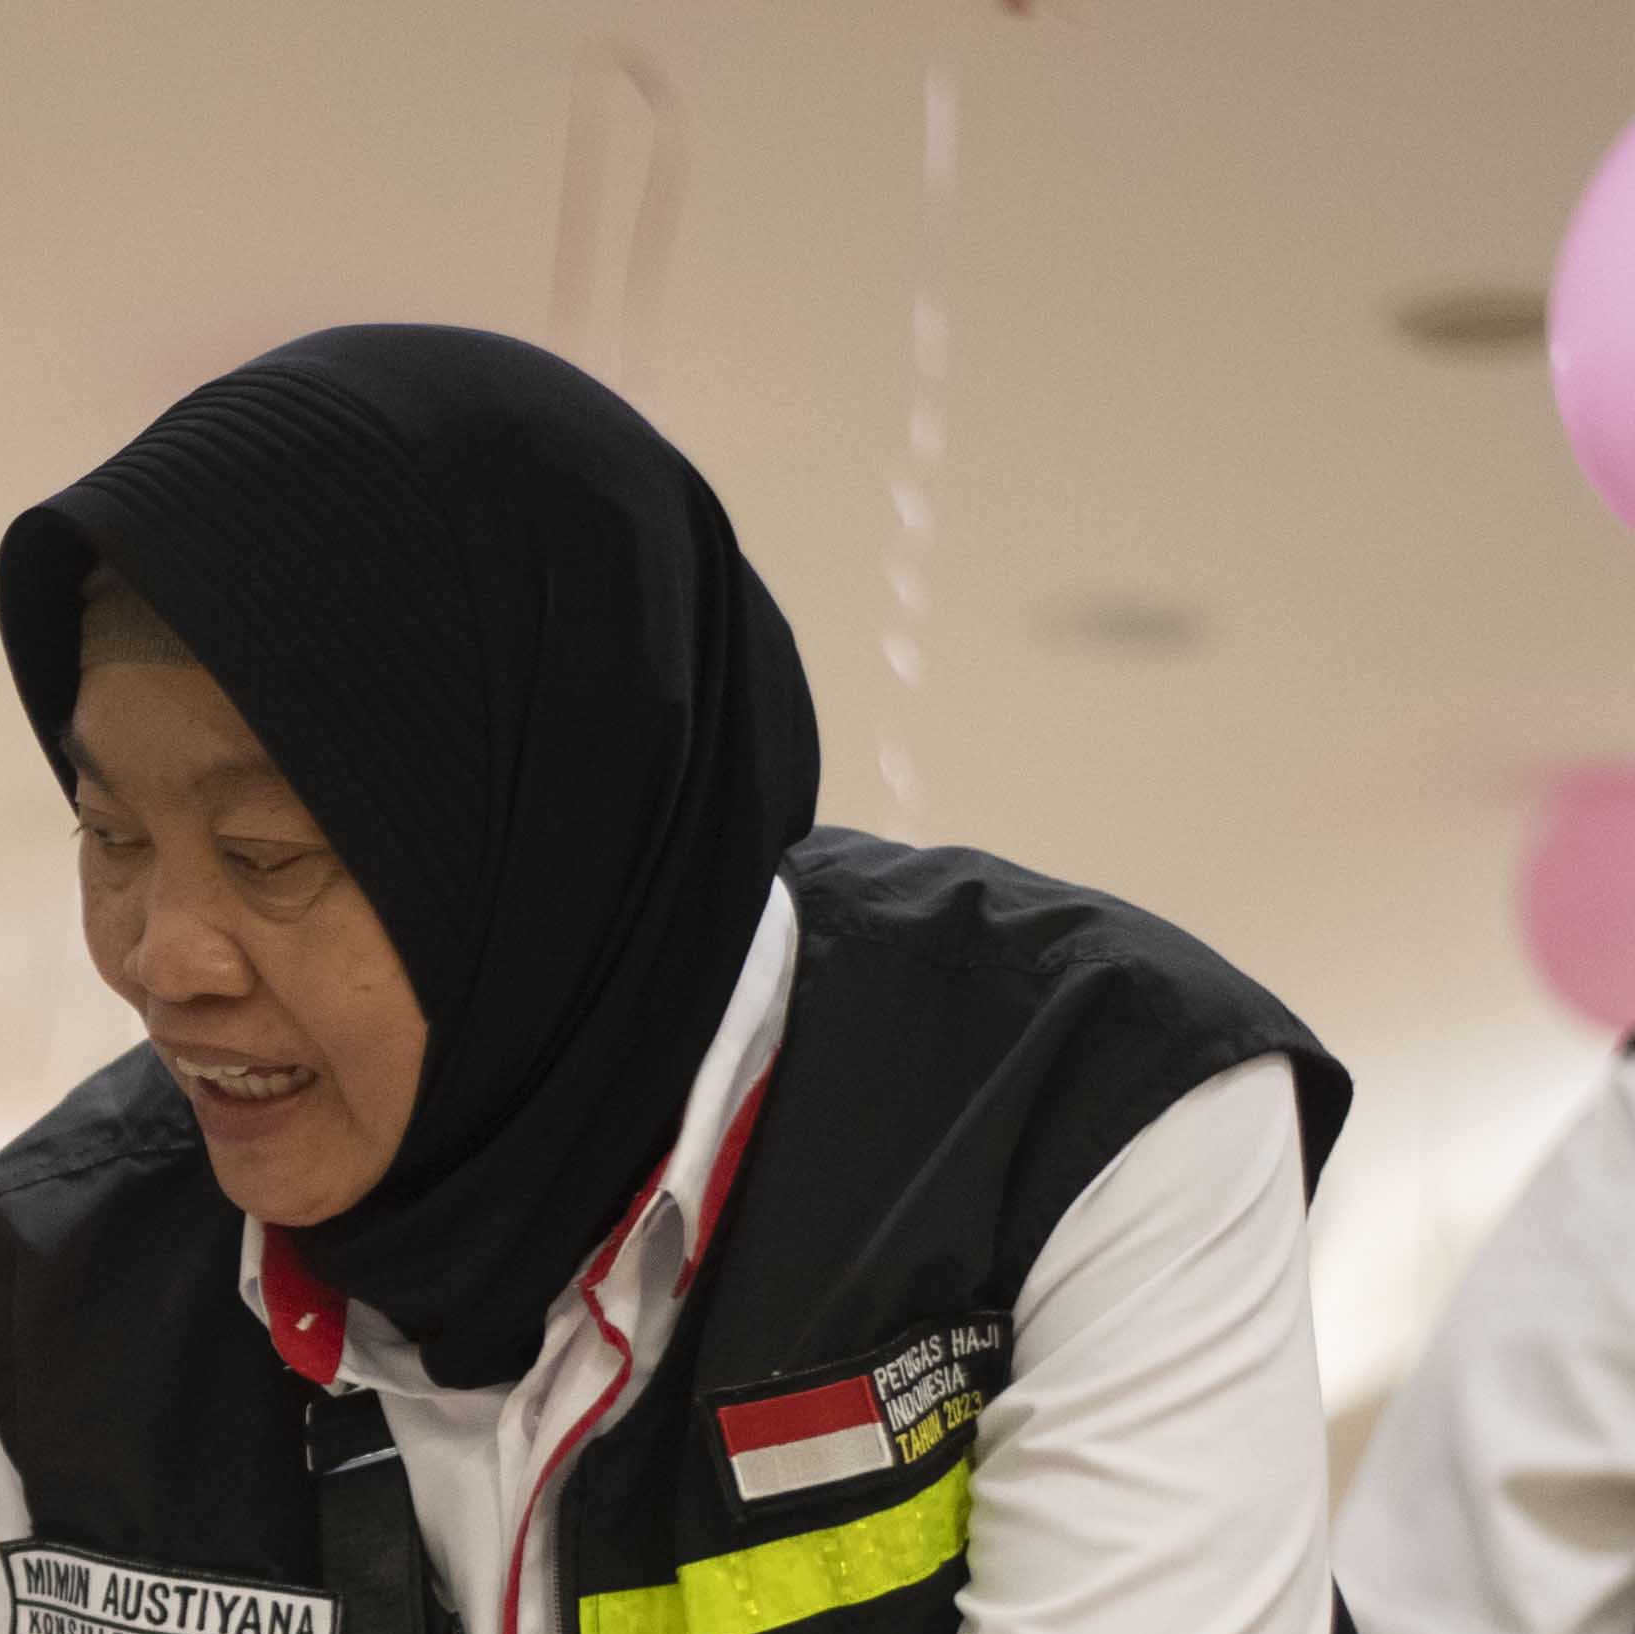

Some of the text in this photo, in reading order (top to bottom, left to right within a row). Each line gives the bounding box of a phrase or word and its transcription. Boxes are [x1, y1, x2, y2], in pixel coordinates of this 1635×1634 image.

[873, 1324, 1000, 1400] PETUGAS HAJI
[886, 1363, 965, 1432] INDONESIA
[896, 1392, 981, 1464] TAHUN 2023
[23, 1557, 90, 1609] MIMIN
